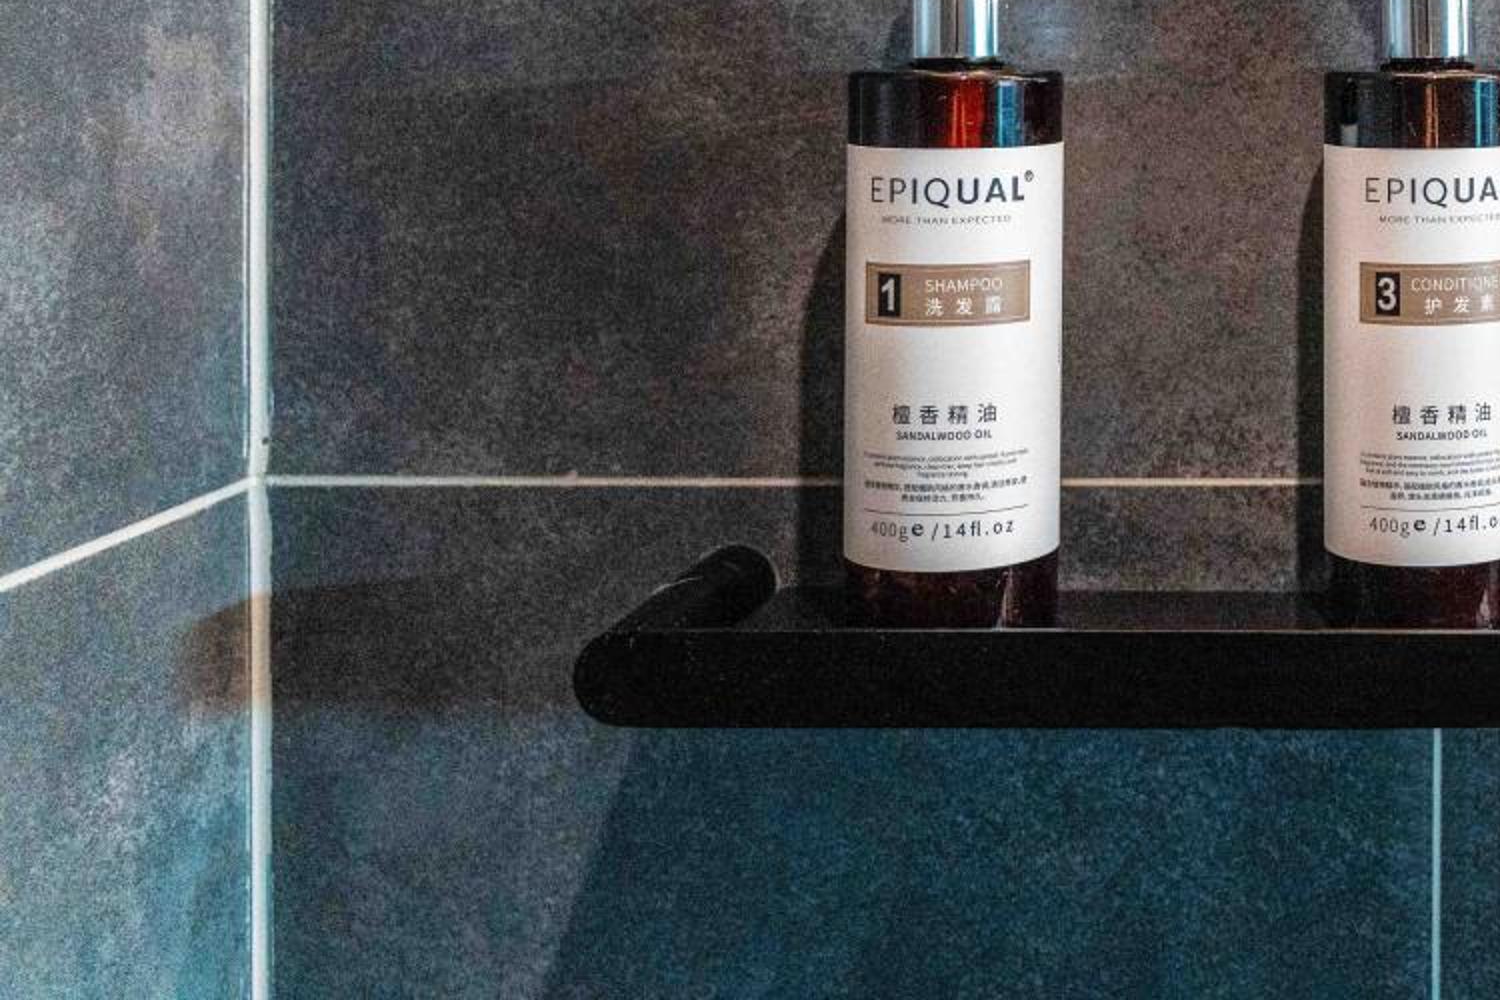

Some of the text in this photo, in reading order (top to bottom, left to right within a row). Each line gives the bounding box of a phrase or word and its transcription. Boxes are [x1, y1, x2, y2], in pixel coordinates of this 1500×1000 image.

[881, 277, 895, 311] 1
[924, 278, 1003, 294] SHAMPOO
[1377, 276, 1397, 311] 3
[893, 403, 998, 425] 檀香精油
[1392, 402, 1491, 425] 檀香精油
[896, 428, 993, 441] SANDALWOOD OIL
